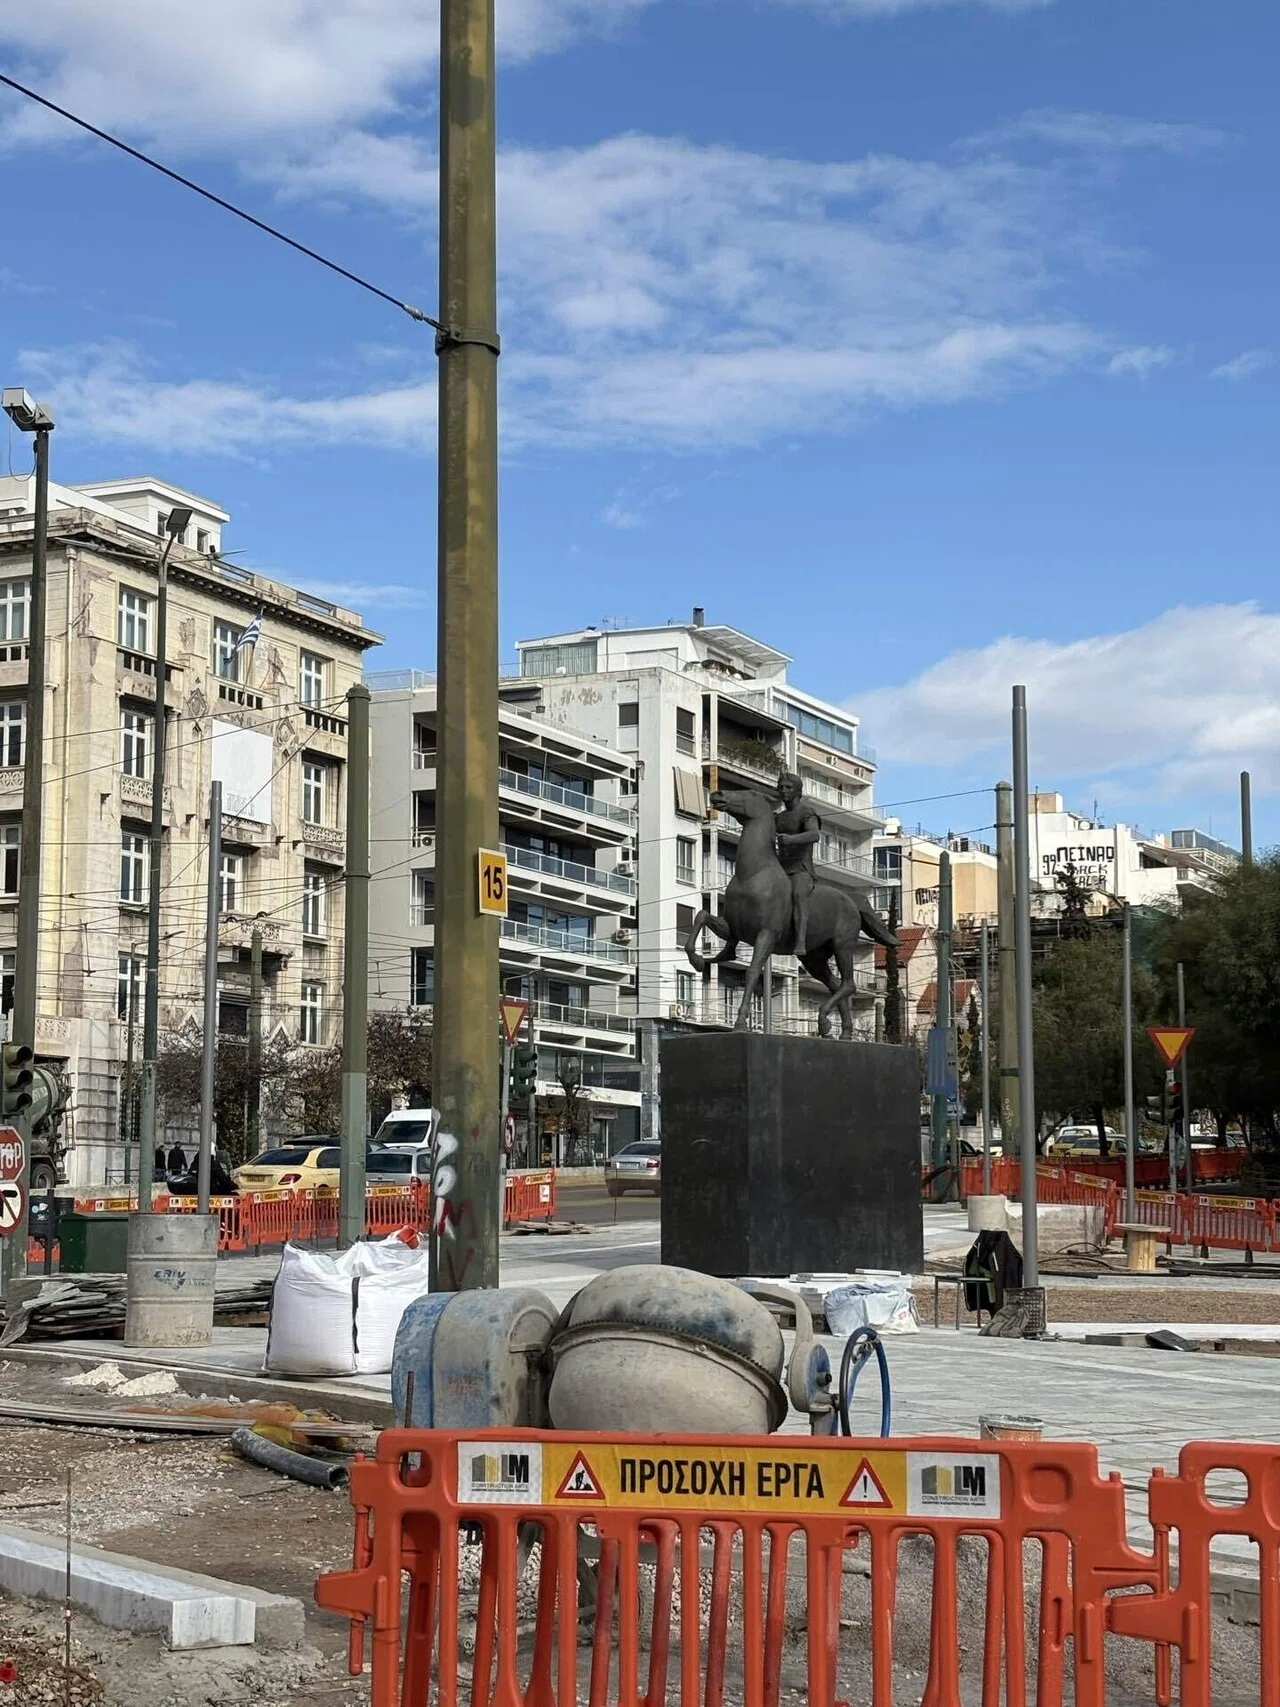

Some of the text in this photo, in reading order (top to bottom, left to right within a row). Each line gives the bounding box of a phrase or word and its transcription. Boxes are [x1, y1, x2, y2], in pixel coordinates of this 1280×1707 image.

[483, 864, 503, 900] 15
[0, 1142, 21, 1169] TOP
[620, 1458, 825, 1499] ΠΡΟΣΟΧΗ ΕΡΓΑ
